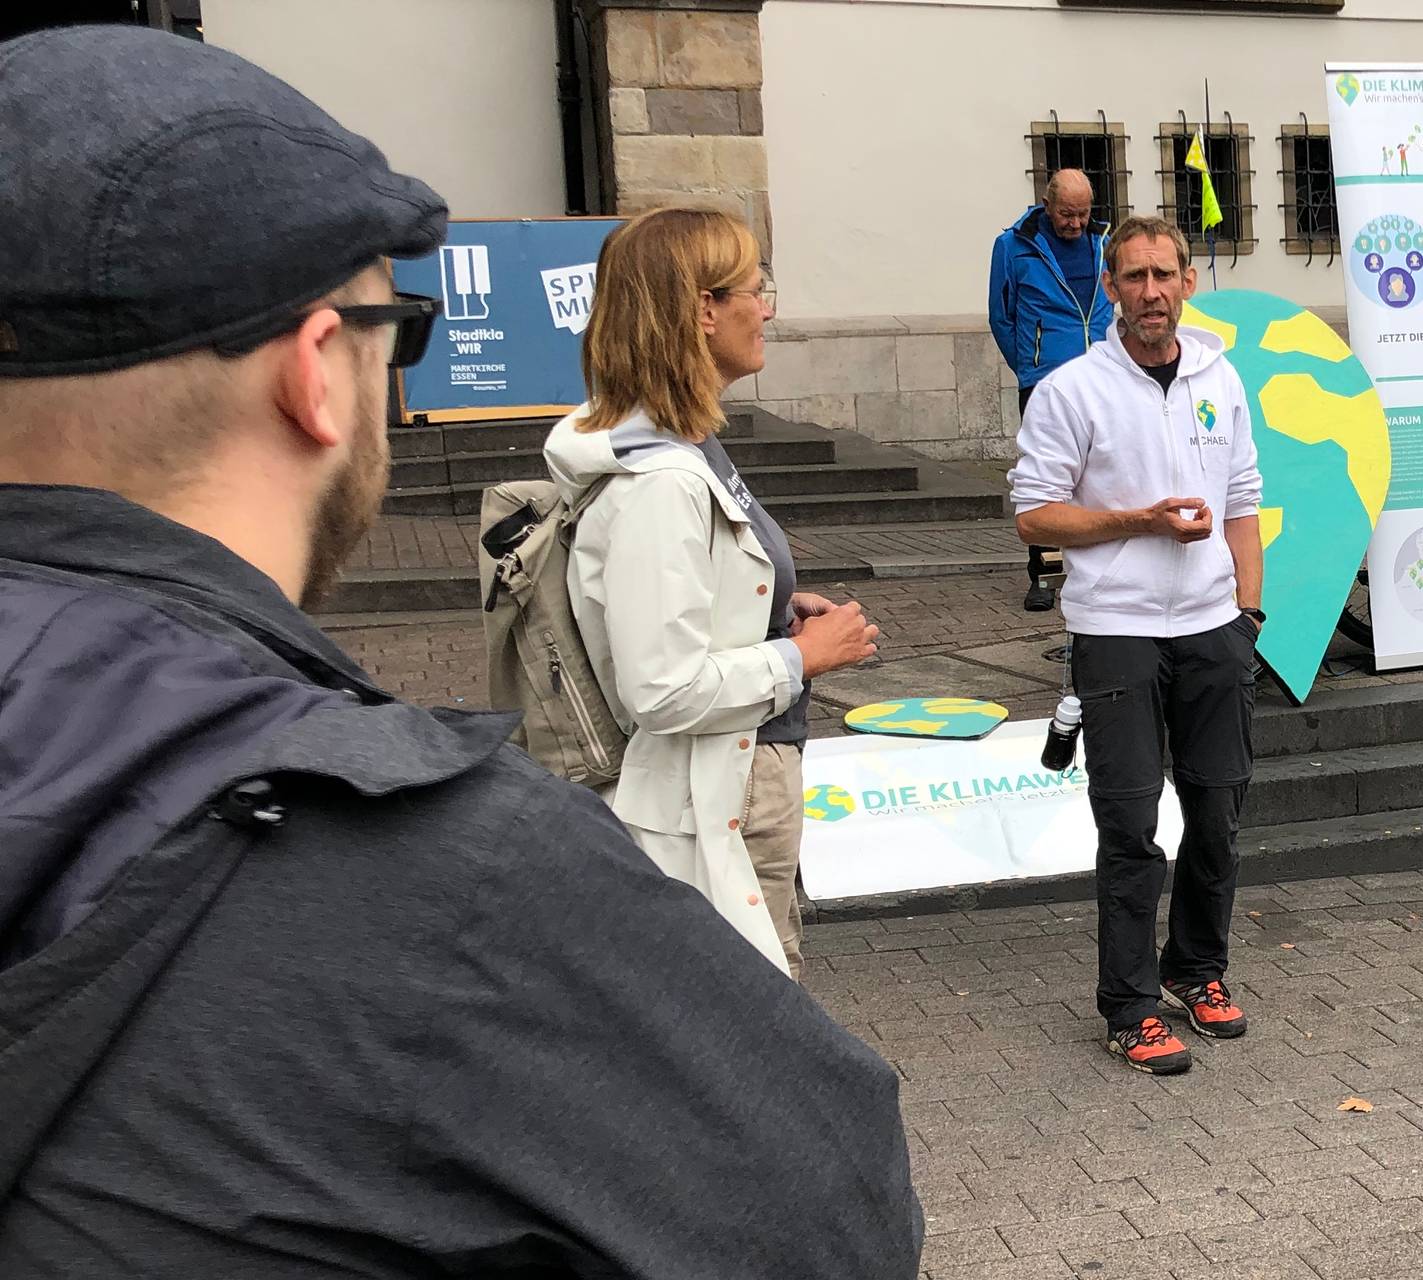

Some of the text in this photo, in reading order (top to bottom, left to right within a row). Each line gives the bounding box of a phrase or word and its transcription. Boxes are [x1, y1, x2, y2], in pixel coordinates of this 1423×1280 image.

[1362, 79, 1387, 92] DIE
[1364, 94, 1381, 103] Wir
[448, 329, 504, 341] Stadtkla
[1377, 332, 1407, 344] JETZT
[451, 364, 506, 373] MARKTKIRCHE
[451, 373, 477, 381] ESSEN
[1189, 436, 1229, 446] MCHAEL
[861, 784, 921, 810] DIE
